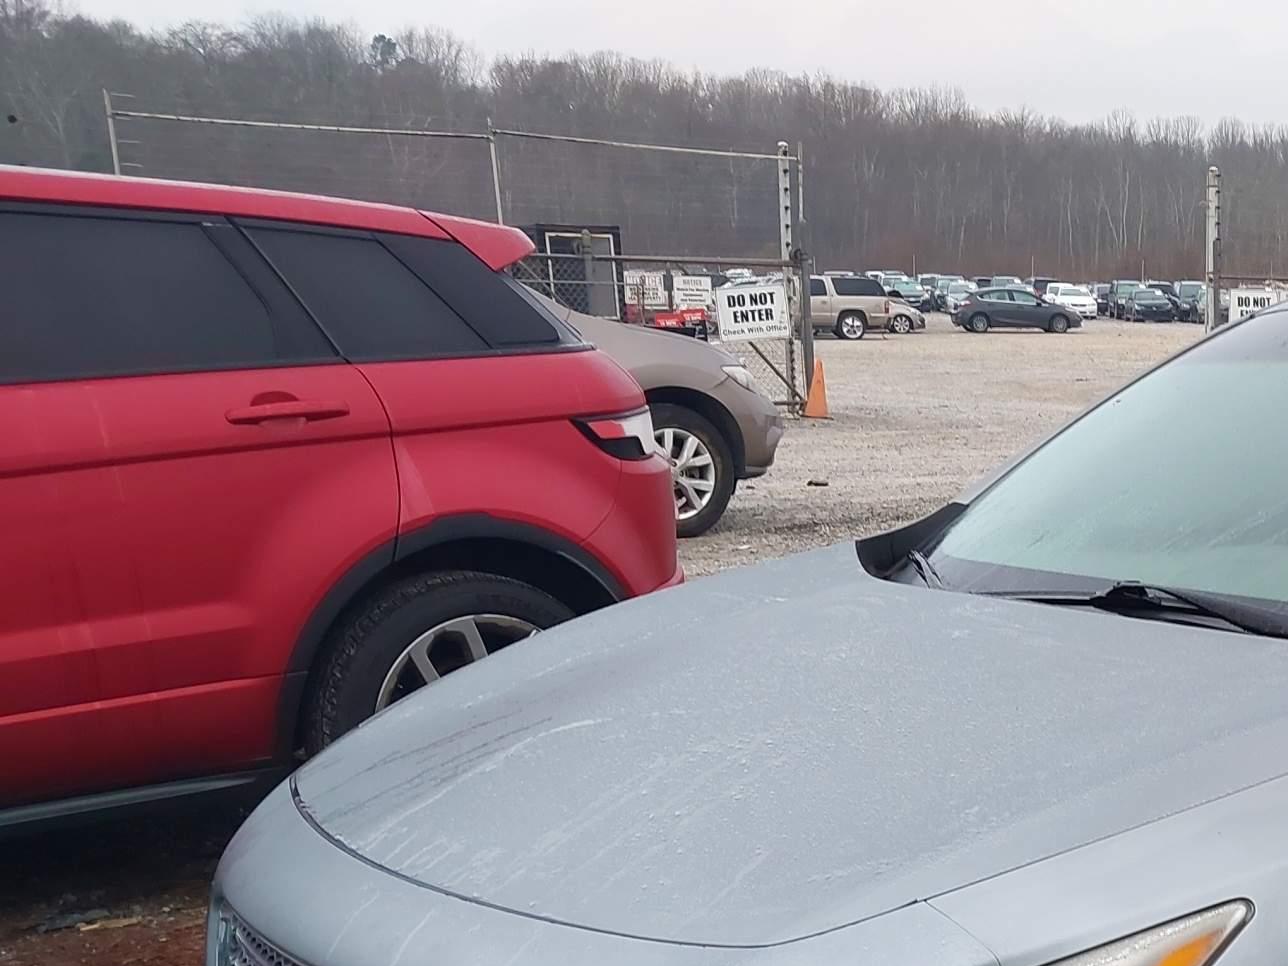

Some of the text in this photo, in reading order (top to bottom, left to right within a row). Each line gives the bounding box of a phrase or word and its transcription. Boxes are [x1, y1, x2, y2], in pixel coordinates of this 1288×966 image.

[726, 291, 775, 308] DO NOT
[1237, 296, 1272, 308] DO NOT
[733, 308, 774, 324] ENTER
[722, 324, 788, 337] Check With Office
